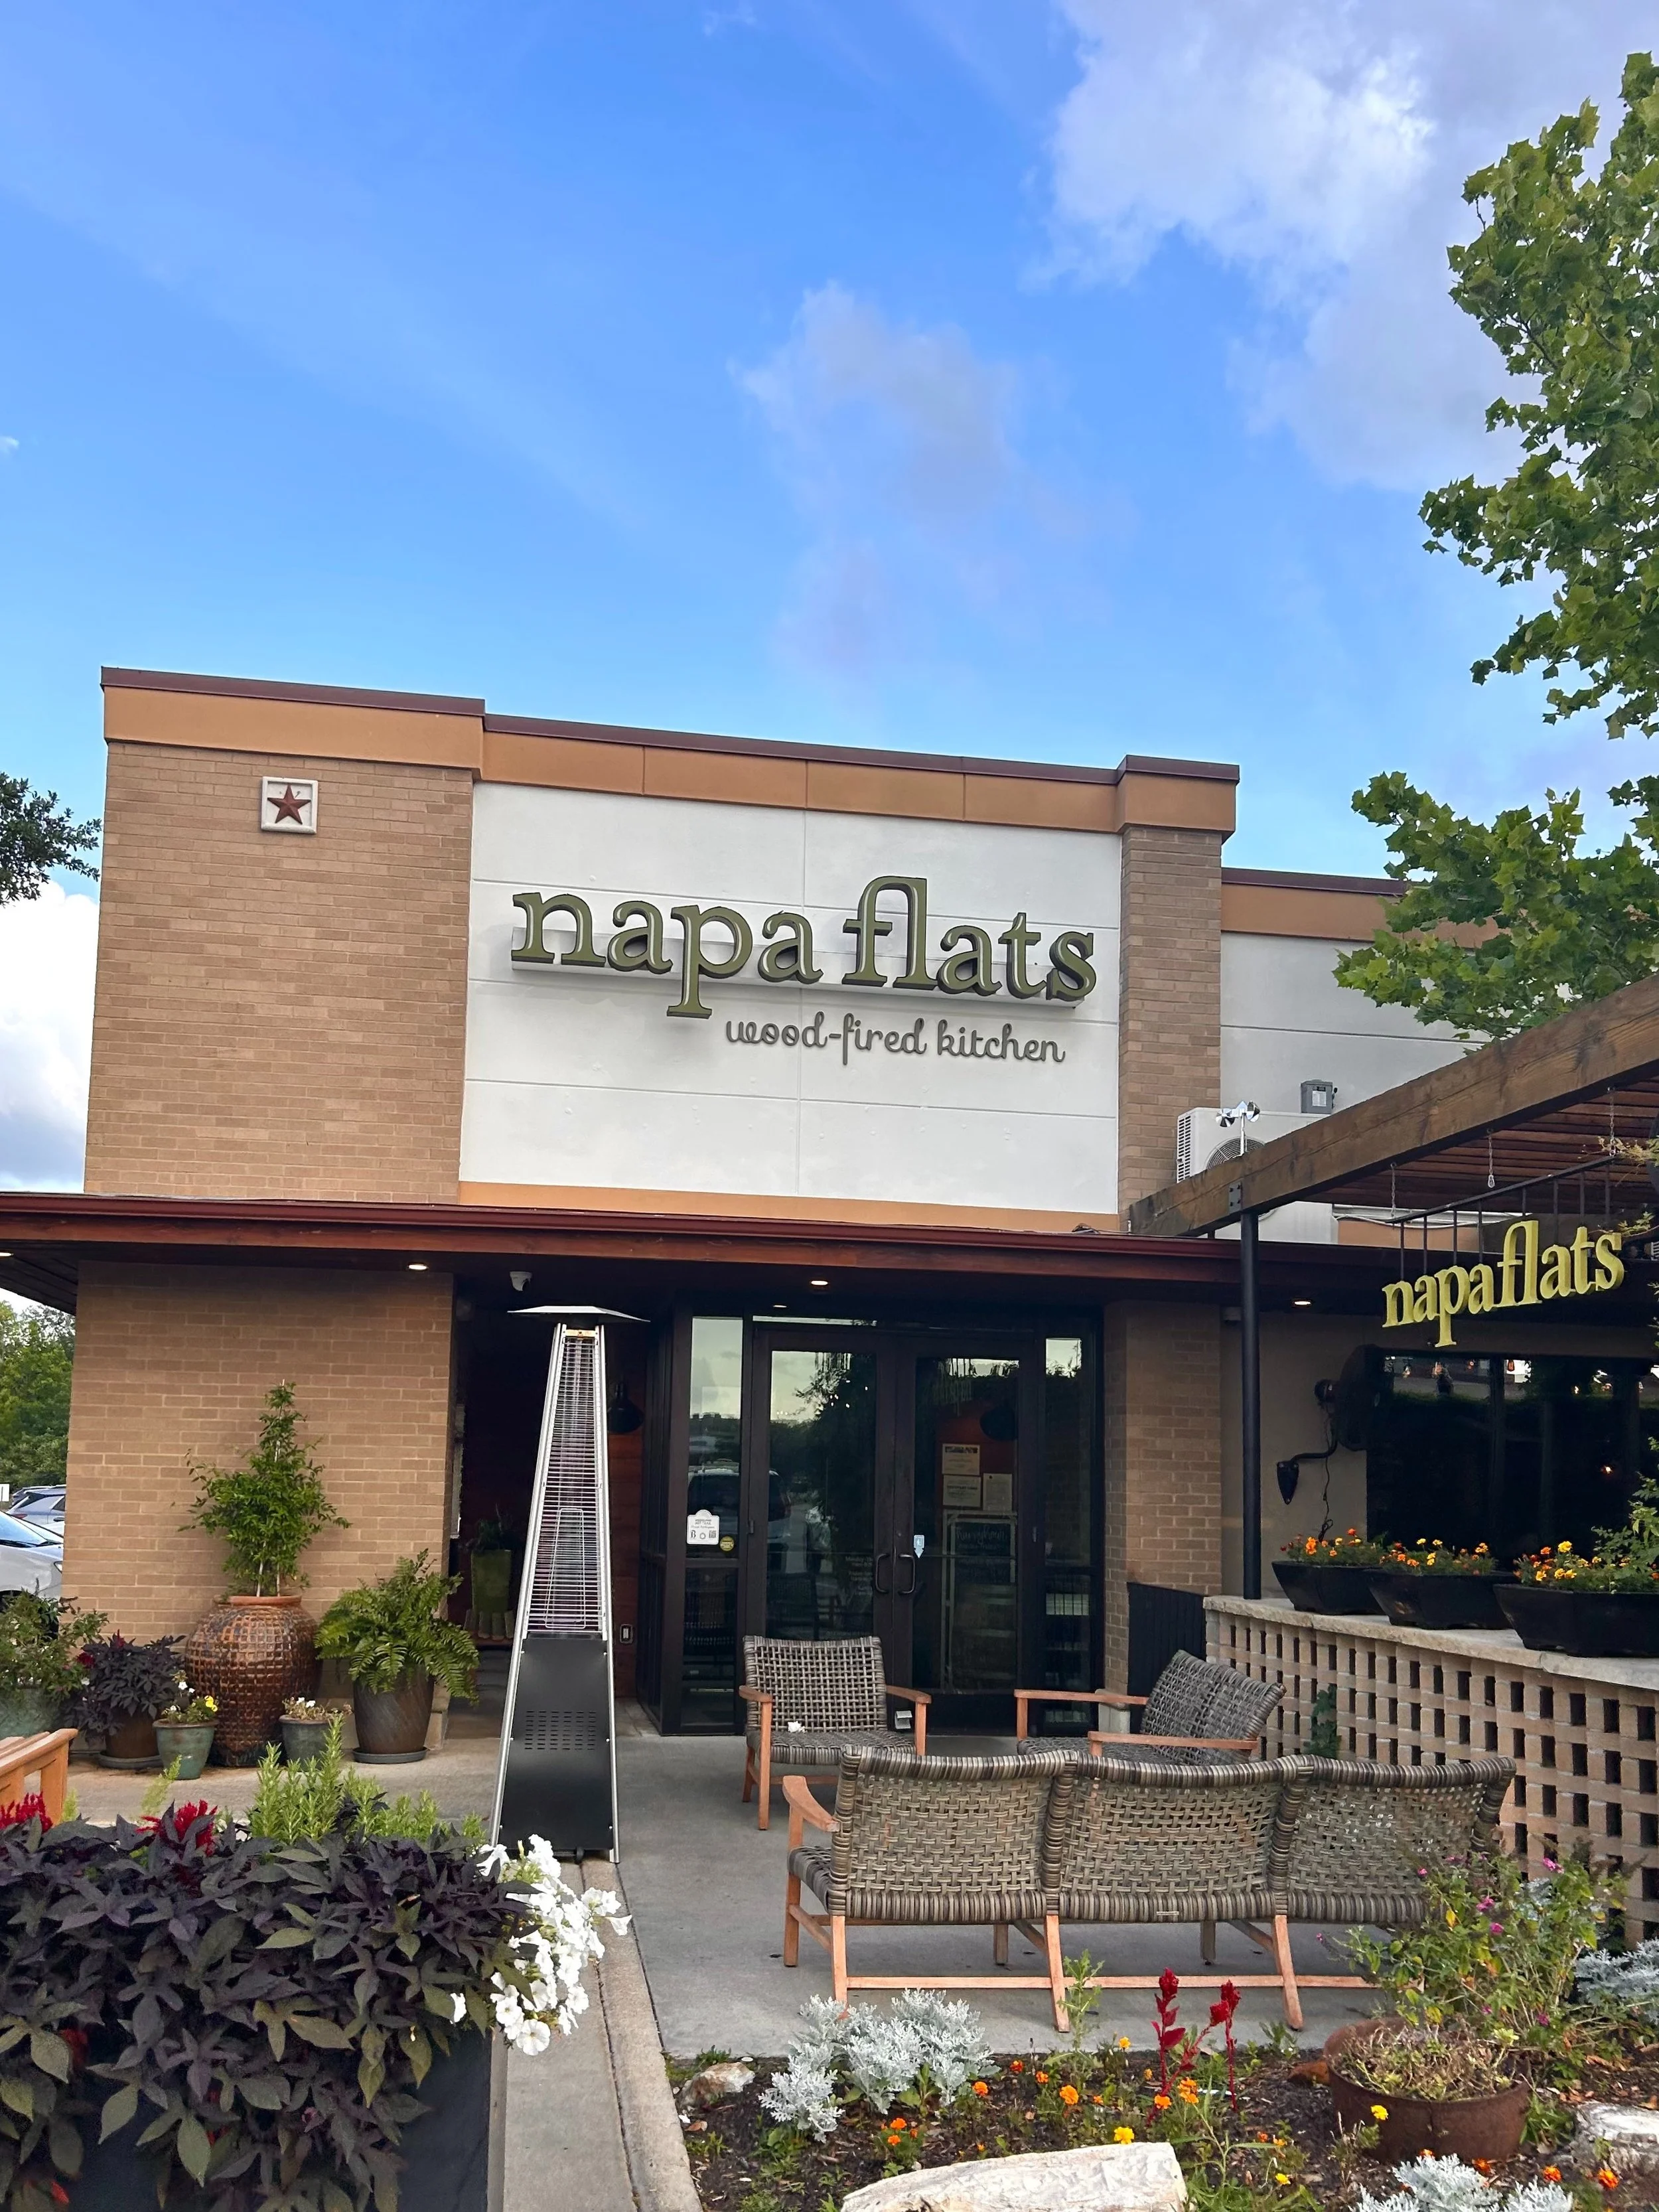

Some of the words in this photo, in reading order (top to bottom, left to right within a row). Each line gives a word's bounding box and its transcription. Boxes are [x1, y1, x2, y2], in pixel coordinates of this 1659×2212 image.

[512, 891, 824, 1018] napa
[842, 875, 1097, 1002] flats
[726, 1011, 927, 1065] wood-fired
[937, 1019, 1066, 1063] kitchen
